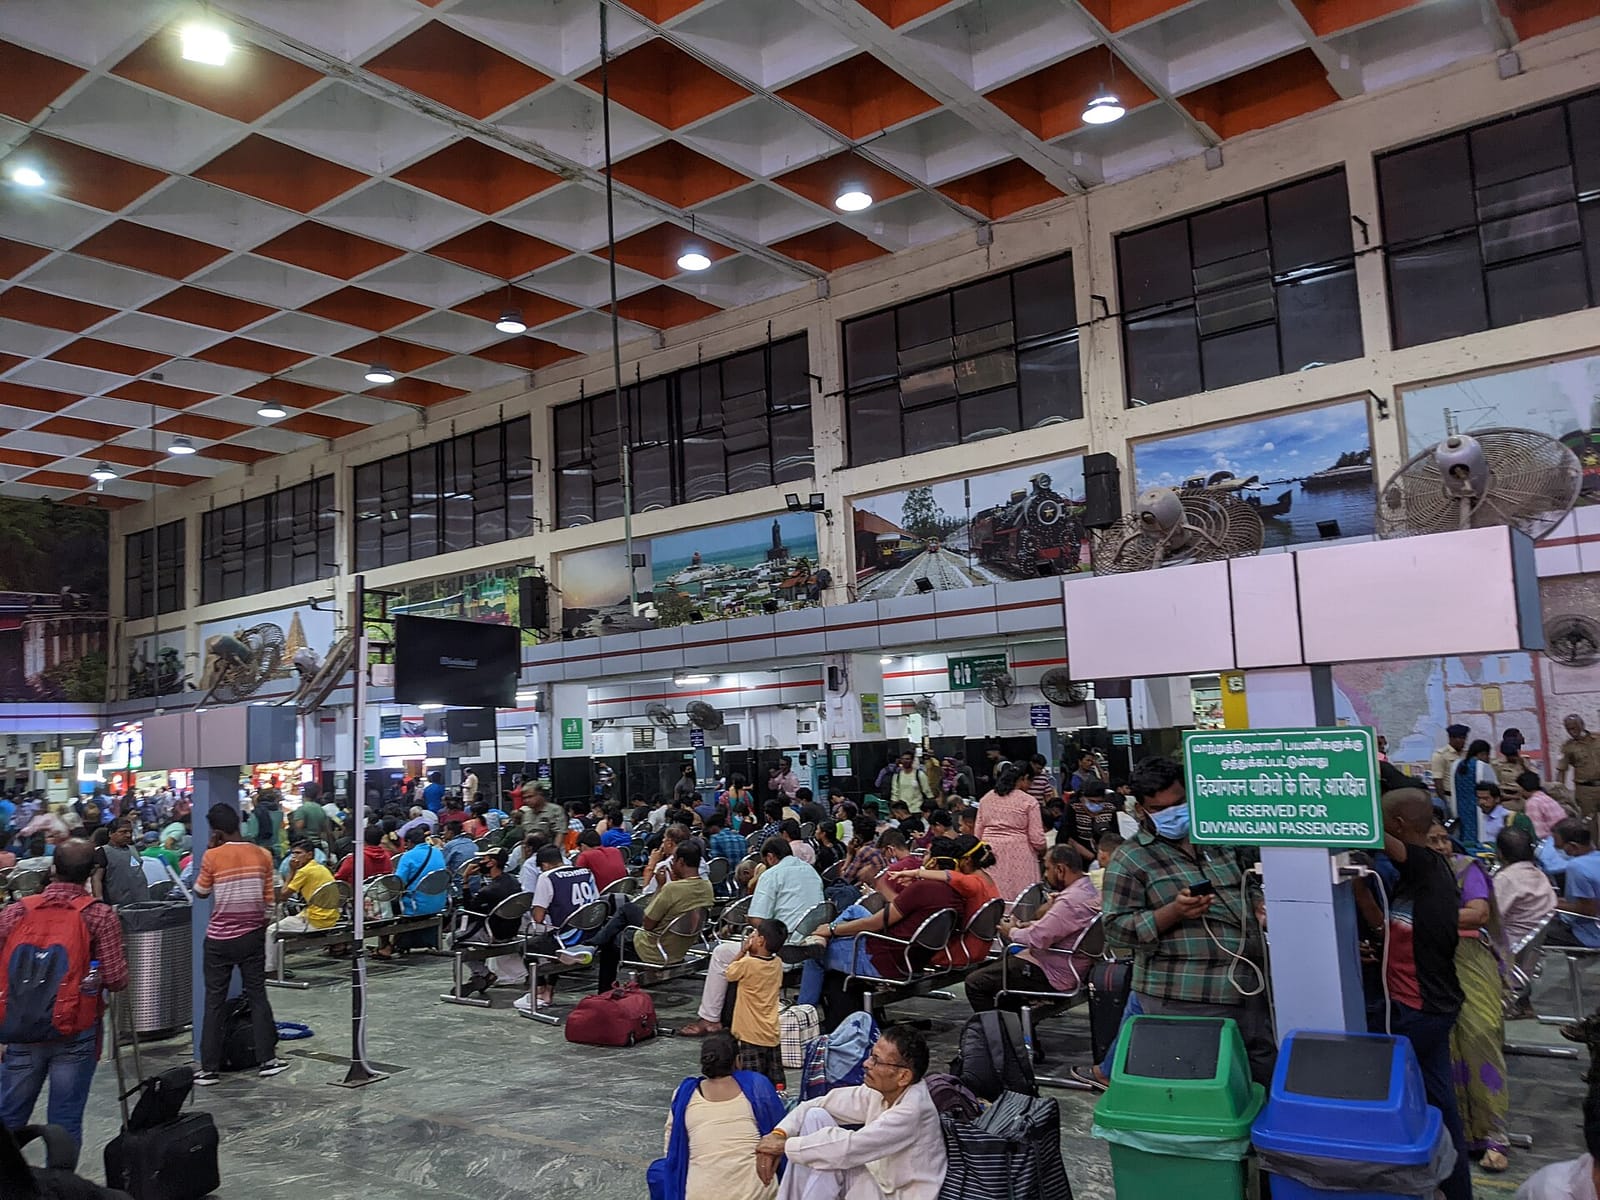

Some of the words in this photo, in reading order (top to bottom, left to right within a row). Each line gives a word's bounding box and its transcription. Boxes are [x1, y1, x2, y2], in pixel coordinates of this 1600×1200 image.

[1285, 737, 1363, 752] பயணிகளுக்கு
[1195, 773, 1248, 797] दिव्यांगजन
[1249, 772, 1283, 797] यात्रियों
[1284, 772, 1296, 796] के
[1299, 772, 1321, 798] लिए
[1323, 772, 1367, 797] आरक्षित
[1228, 804, 1297, 818] RESERVED
[1299, 804, 1328, 818] FOR
[1199, 820, 1279, 835] DIVYANGJAN
[1280, 821, 1370, 836] PASSENGERS
